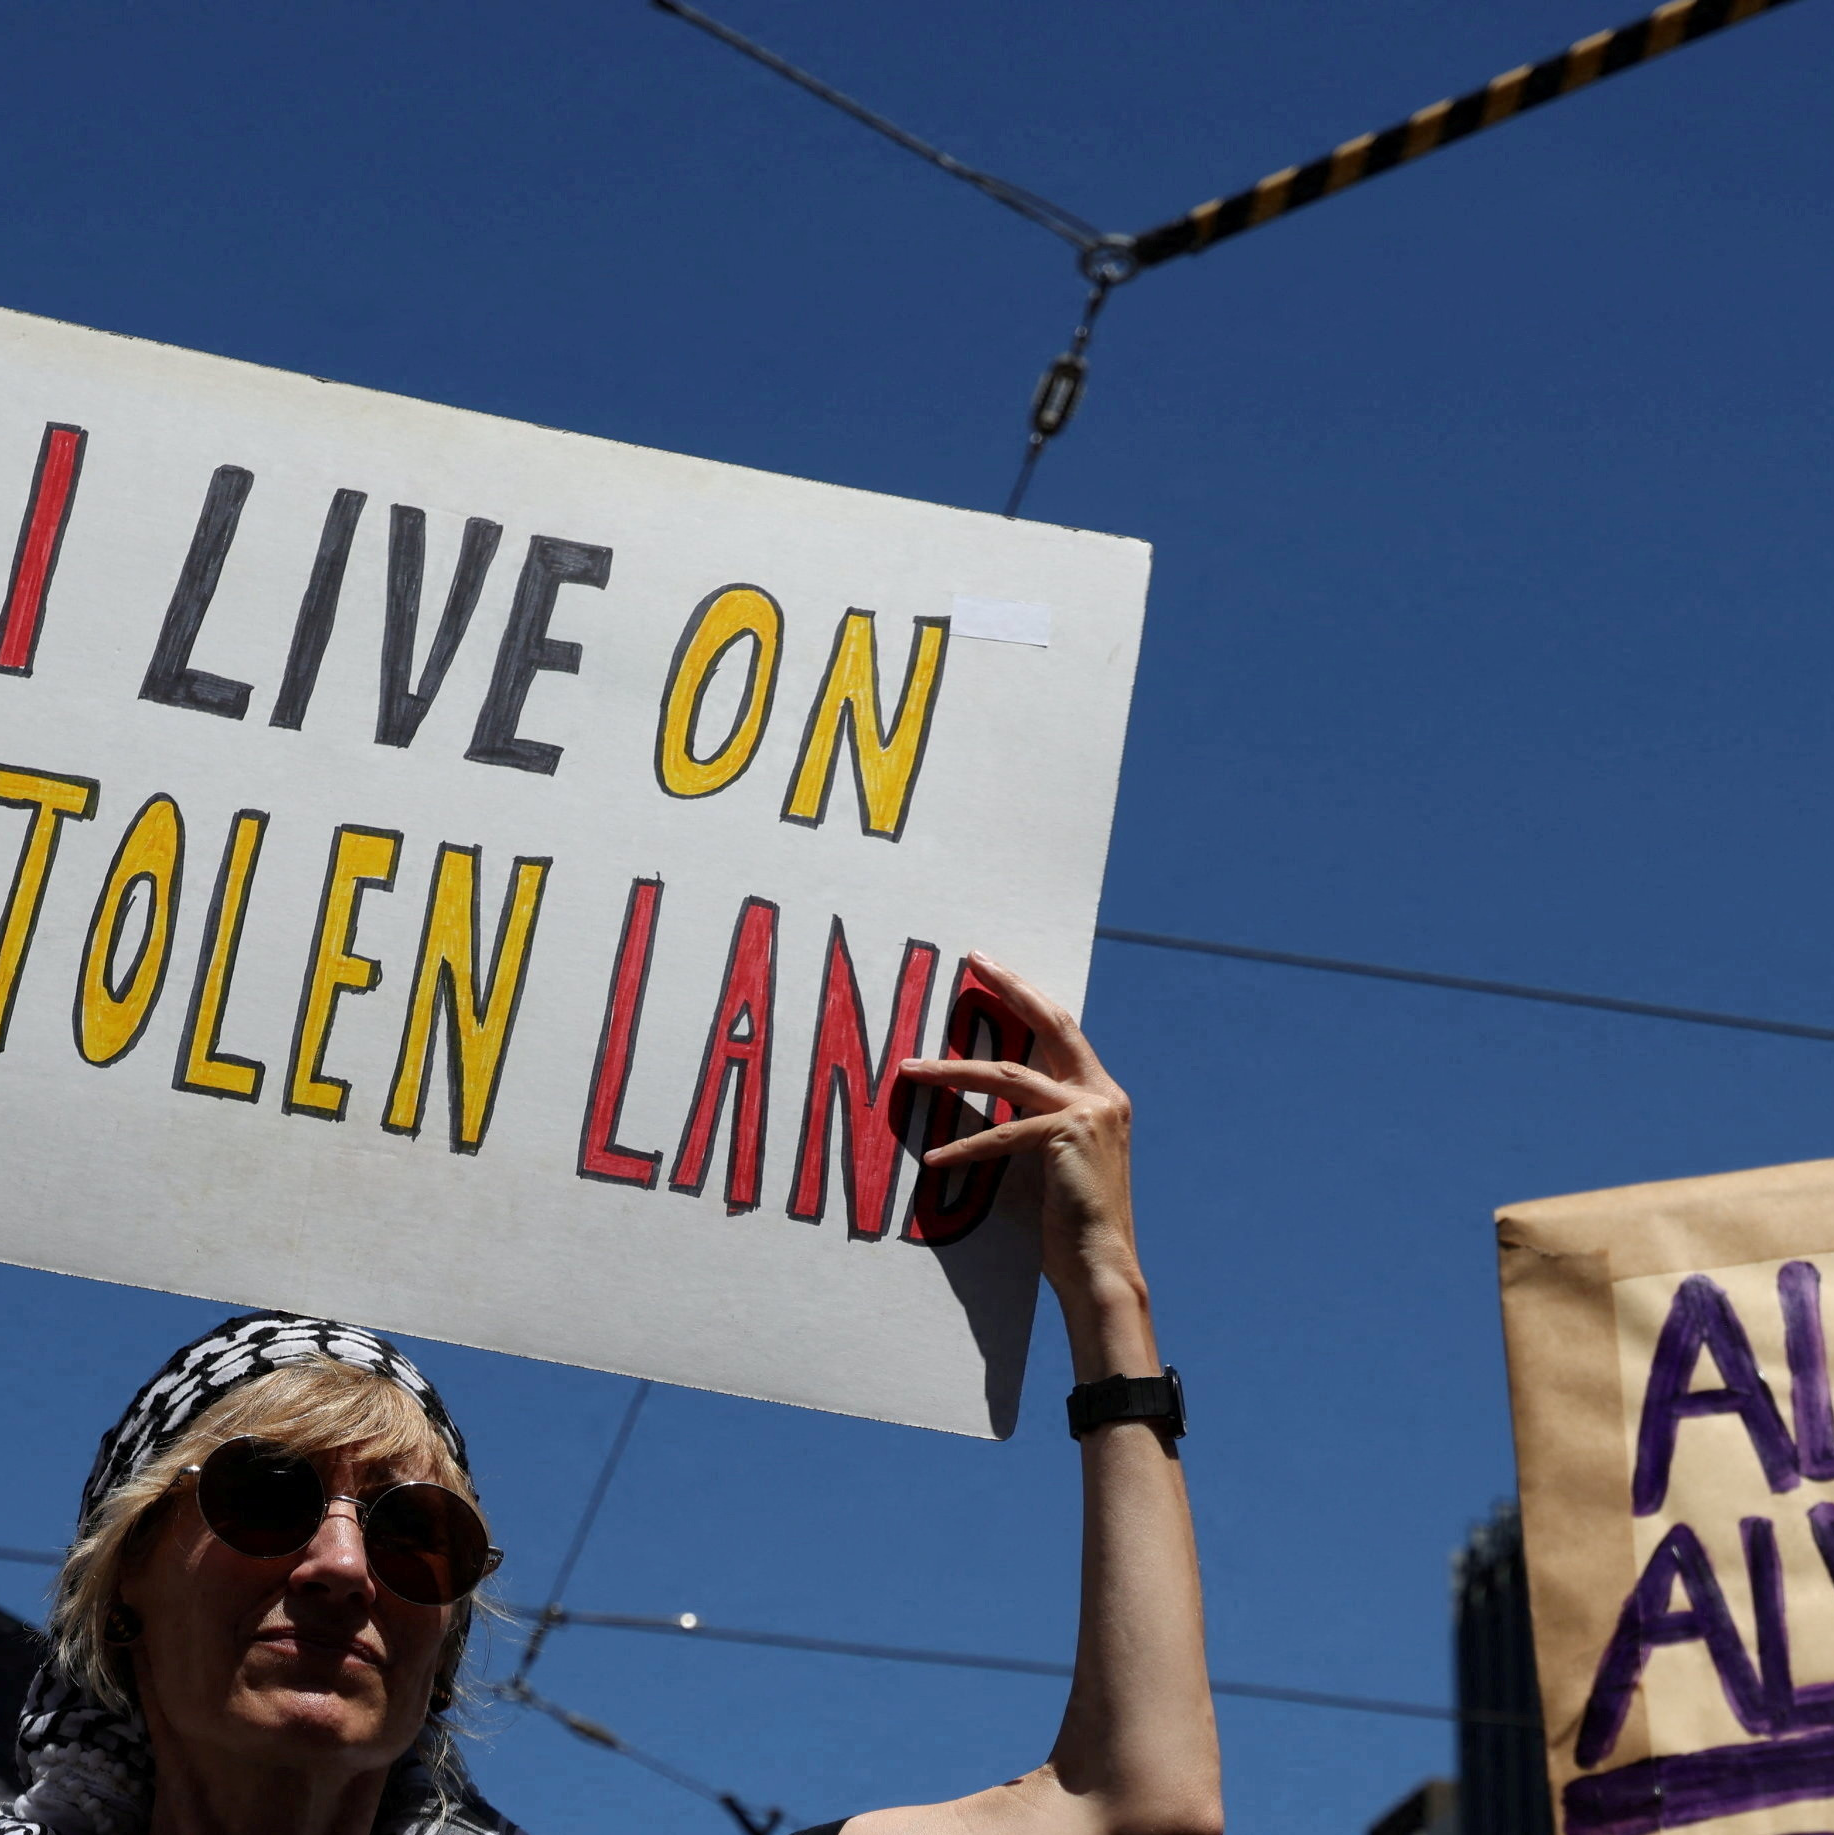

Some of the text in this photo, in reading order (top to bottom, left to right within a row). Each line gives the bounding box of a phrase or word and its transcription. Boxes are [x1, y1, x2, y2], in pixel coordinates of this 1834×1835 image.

[137, 464, 614, 776] LIVE
[653, 582, 951, 842] ON
[577, 871, 1035, 1248] LAND
